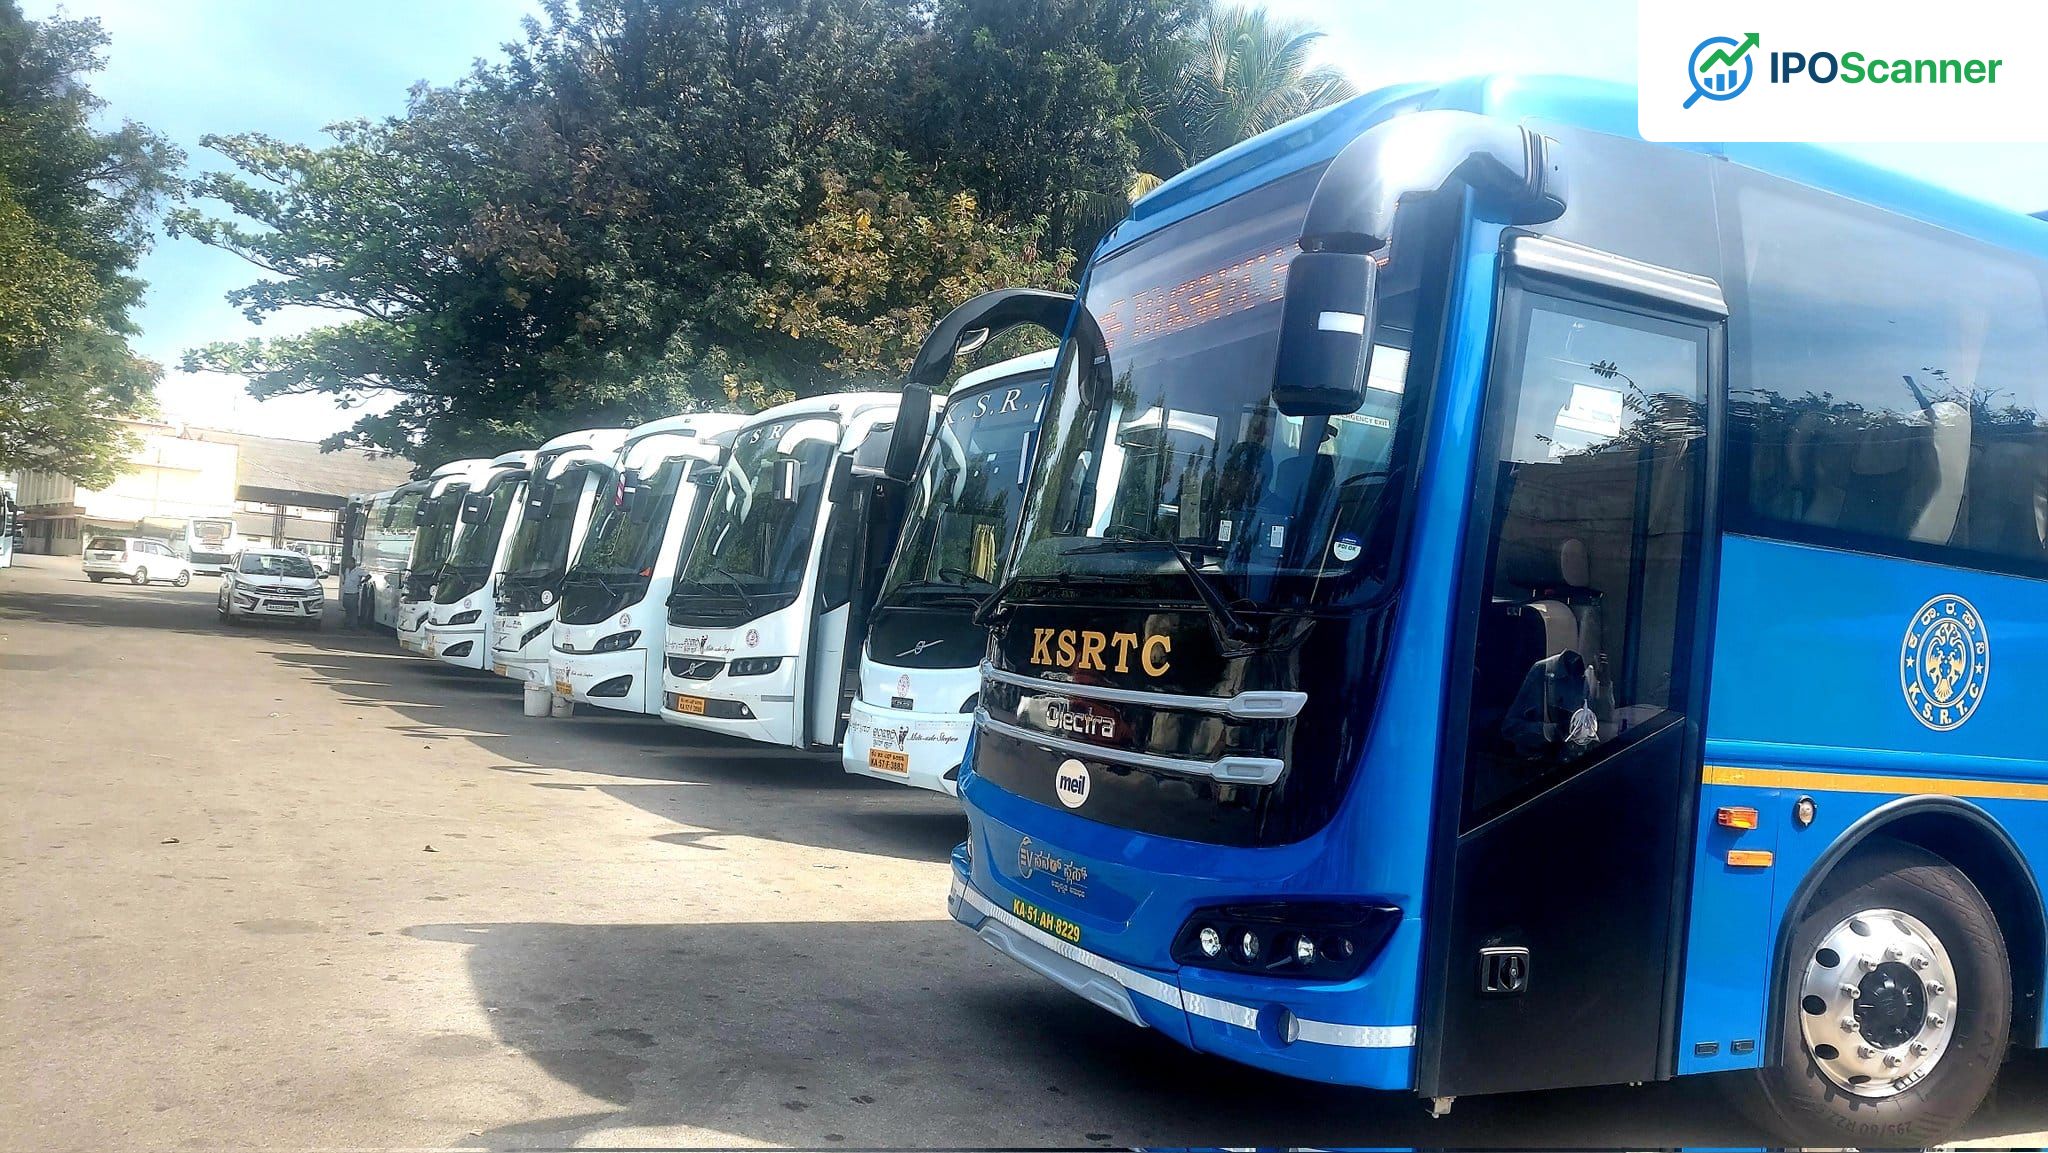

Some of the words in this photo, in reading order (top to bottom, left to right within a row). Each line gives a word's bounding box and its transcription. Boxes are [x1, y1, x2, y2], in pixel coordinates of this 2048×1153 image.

[1030, 628, 1172, 677] KSRTC
[1046, 705, 1116, 738] Olectra
[1060, 773, 1086, 796] meil
